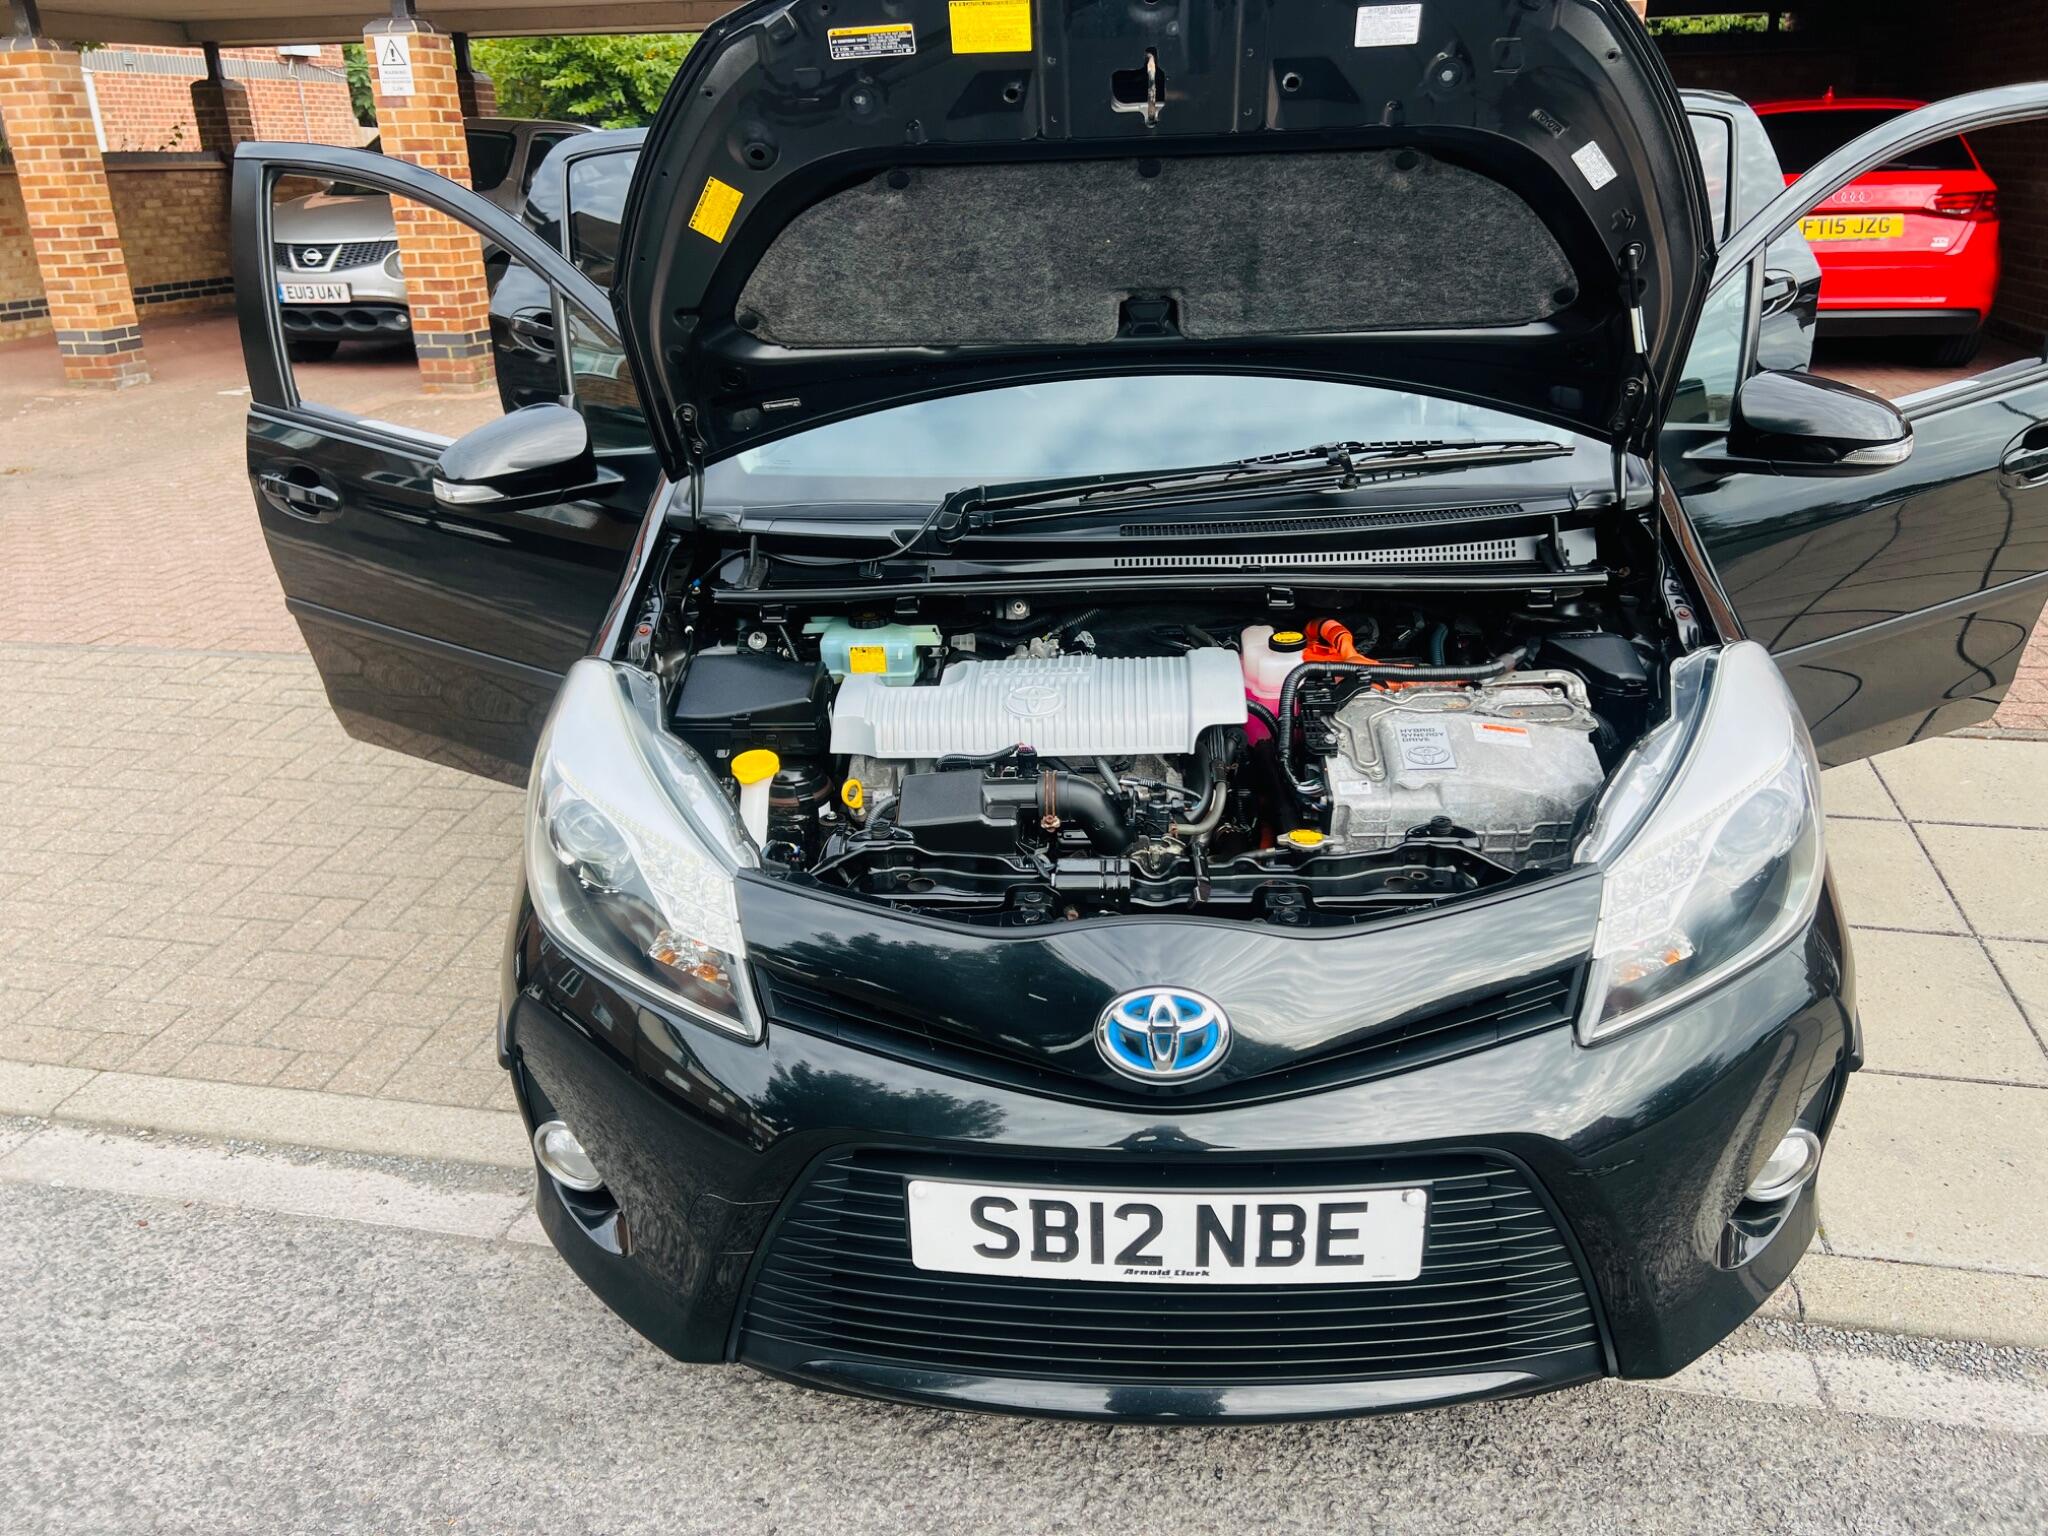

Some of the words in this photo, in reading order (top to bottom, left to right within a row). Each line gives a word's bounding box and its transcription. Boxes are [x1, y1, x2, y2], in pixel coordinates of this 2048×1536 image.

[1536, 110, 1563, 136] TOYOTA
[1802, 217, 1846, 236] FT15
[1853, 216, 1890, 234] JZG
[286, 286, 314, 300] EU13
[317, 286, 342, 300] UAV
[970, 1195, 1164, 1267] SB12
[1195, 1201, 1369, 1268] NBE
[1123, 1268, 1171, 1277] Arnold
[1174, 1269, 1210, 1277] Clark
